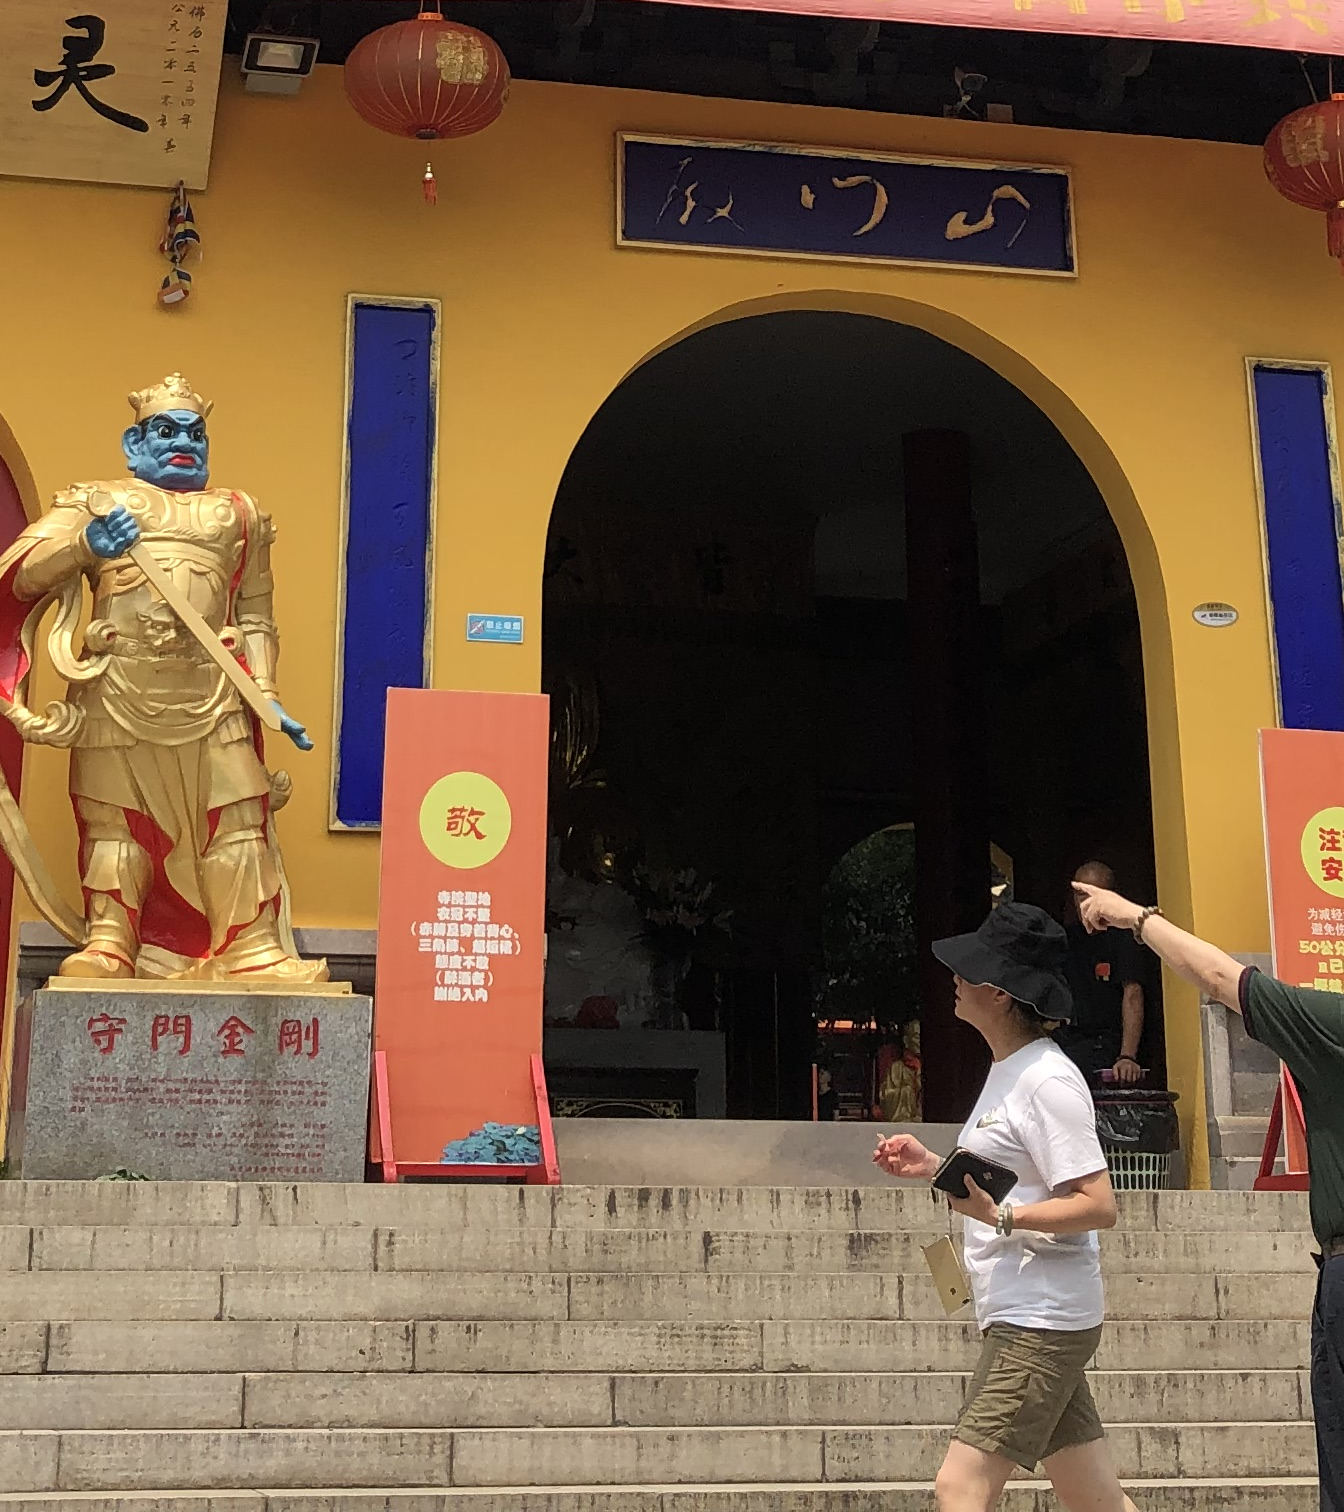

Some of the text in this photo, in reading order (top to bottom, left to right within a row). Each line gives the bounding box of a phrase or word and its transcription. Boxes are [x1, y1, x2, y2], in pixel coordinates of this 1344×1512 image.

[446, 806, 487, 840] 敬
[86, 1012, 320, 1060] 守門金剛
